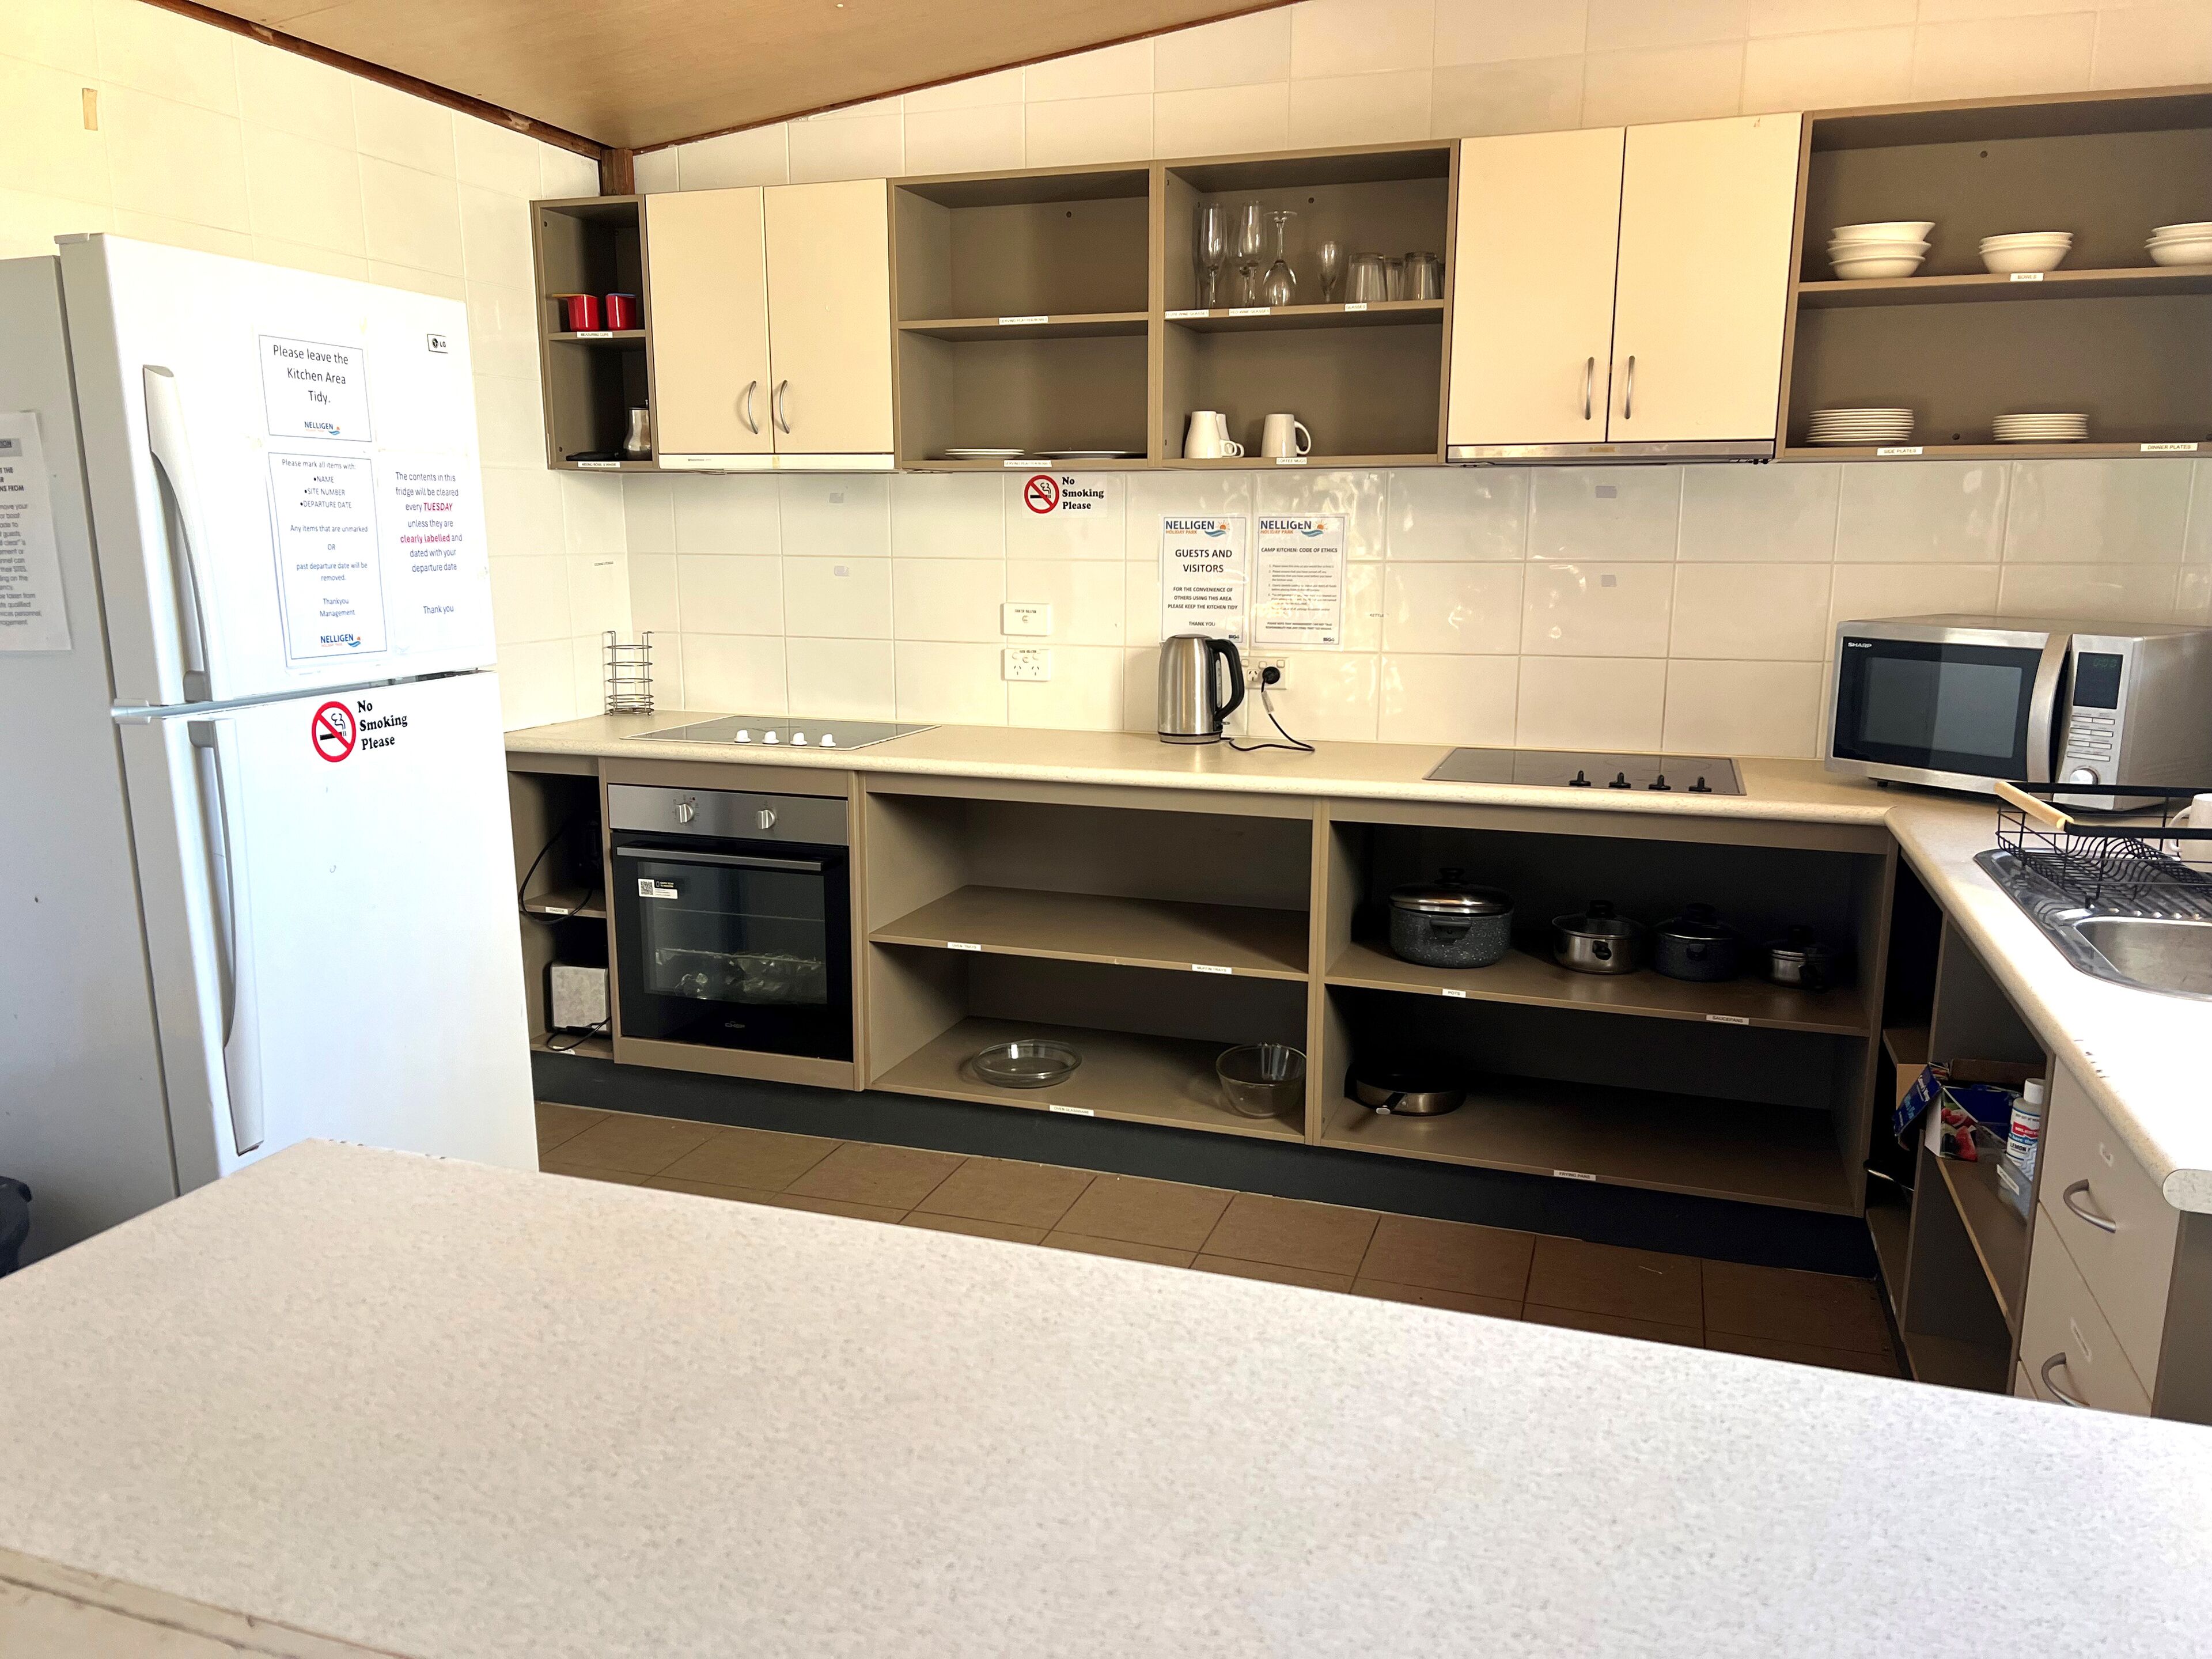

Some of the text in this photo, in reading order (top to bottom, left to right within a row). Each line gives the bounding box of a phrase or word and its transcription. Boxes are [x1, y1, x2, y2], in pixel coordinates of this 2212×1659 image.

[274, 344, 349, 365] Please leave the
[287, 368, 346, 384] Kitchen Area
[308, 390, 331, 405] Tidy.
[304, 421, 334, 430] NELLIGEN
[282, 459, 301, 467] Please
[396, 471, 407, 480] The
[408, 472, 437, 482] contents
[444, 474, 456, 482] this
[1062, 476, 1075, 485] No
[396, 487, 459, 498] fridge will be cleared
[1062, 489, 1104, 499] Smoking
[406, 502, 453, 513] every TUESDAY
[1062, 502, 1092, 510] Please
[290, 525, 301, 533] Any
[407, 520, 429, 528] unless
[430, 519, 442, 529] they
[1165, 521, 1214, 529] NELLIGEN
[1260, 520, 1312, 529] NELLIGEN
[400, 534, 423, 544] clearly
[424, 534, 450, 542] labelled
[410, 548, 456, 558] dated with your
[1175, 549, 1232, 558] GUESTS AND
[310, 562, 336, 571] departure
[412, 563, 457, 574] departure date
[1183, 565, 1224, 573] VISITORS
[323, 598, 349, 606] Thankyou
[320, 609, 355, 618] Management
[423, 605, 454, 615] Thank you
[320, 634, 354, 643] NELLIGEN
[357, 700, 373, 713] No
[359, 715, 408, 732] Smoking
[361, 736, 395, 750] Please
